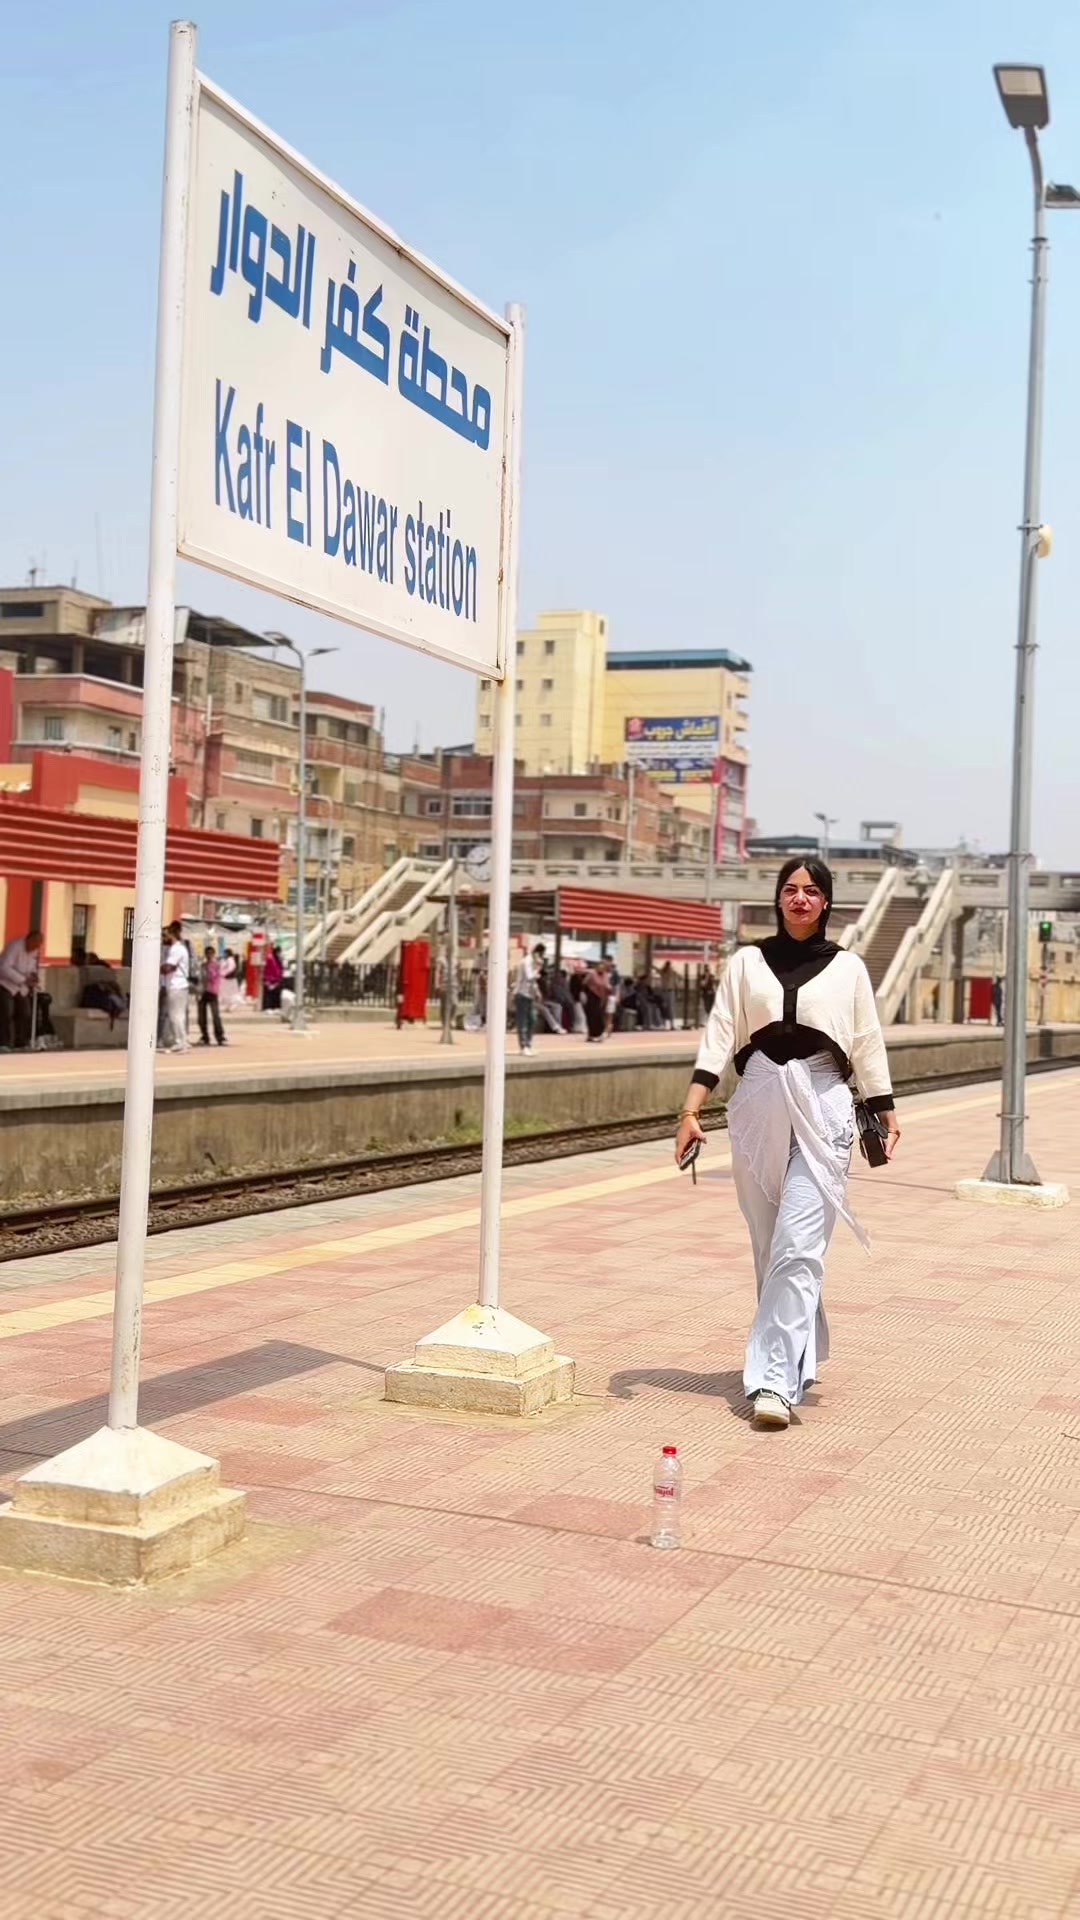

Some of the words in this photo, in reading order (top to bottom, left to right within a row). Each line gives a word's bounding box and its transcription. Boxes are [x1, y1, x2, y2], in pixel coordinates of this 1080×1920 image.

[210, 168, 316, 329] الدوار
[320, 258, 391, 386] كفر
[397, 304, 493, 452] محطة
[214, 377, 276, 531] Kafr
[286, 418, 312, 548] El
[322, 439, 398, 586] Dawar
[404, 500, 478, 623] station
